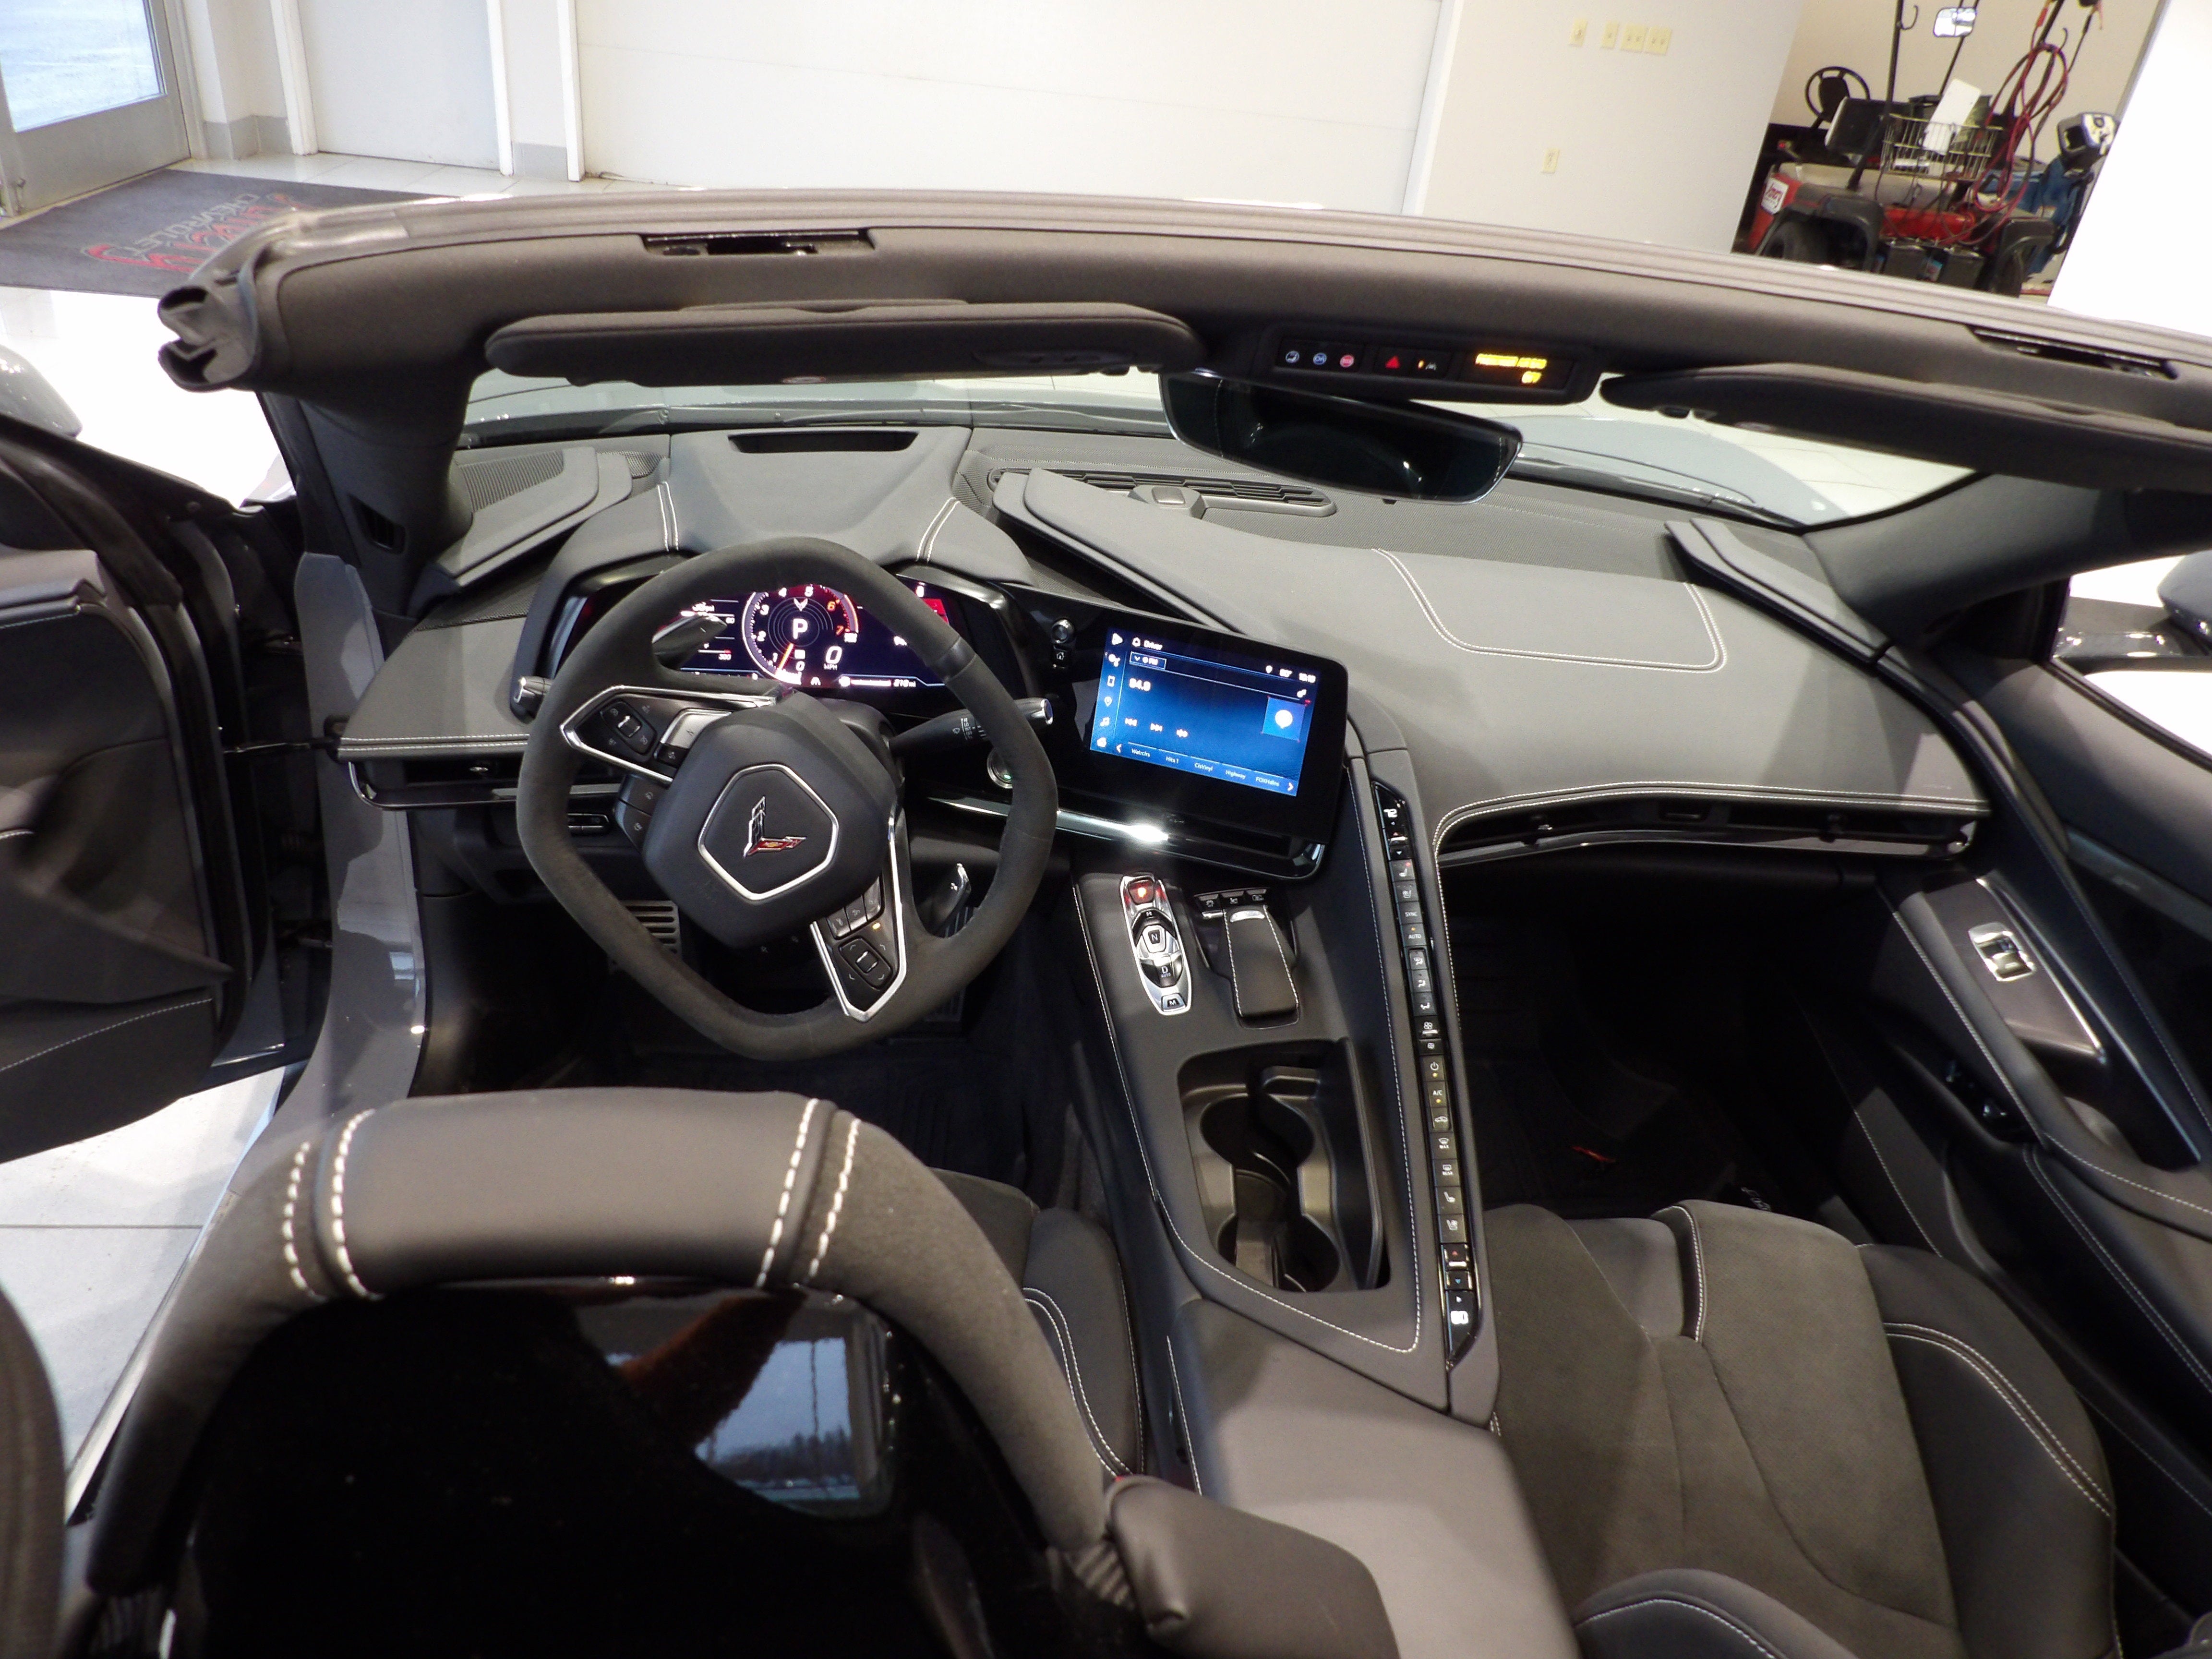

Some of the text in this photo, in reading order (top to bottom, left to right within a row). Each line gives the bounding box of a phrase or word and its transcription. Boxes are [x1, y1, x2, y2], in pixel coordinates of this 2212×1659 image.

[827, 601, 836, 612] 6
[793, 618, 808, 639] P
[836, 625, 844, 635] 7
[826, 646, 842, 664] 0
[796, 661, 805, 671] 0
[1225, 769, 1246, 780] Highway
